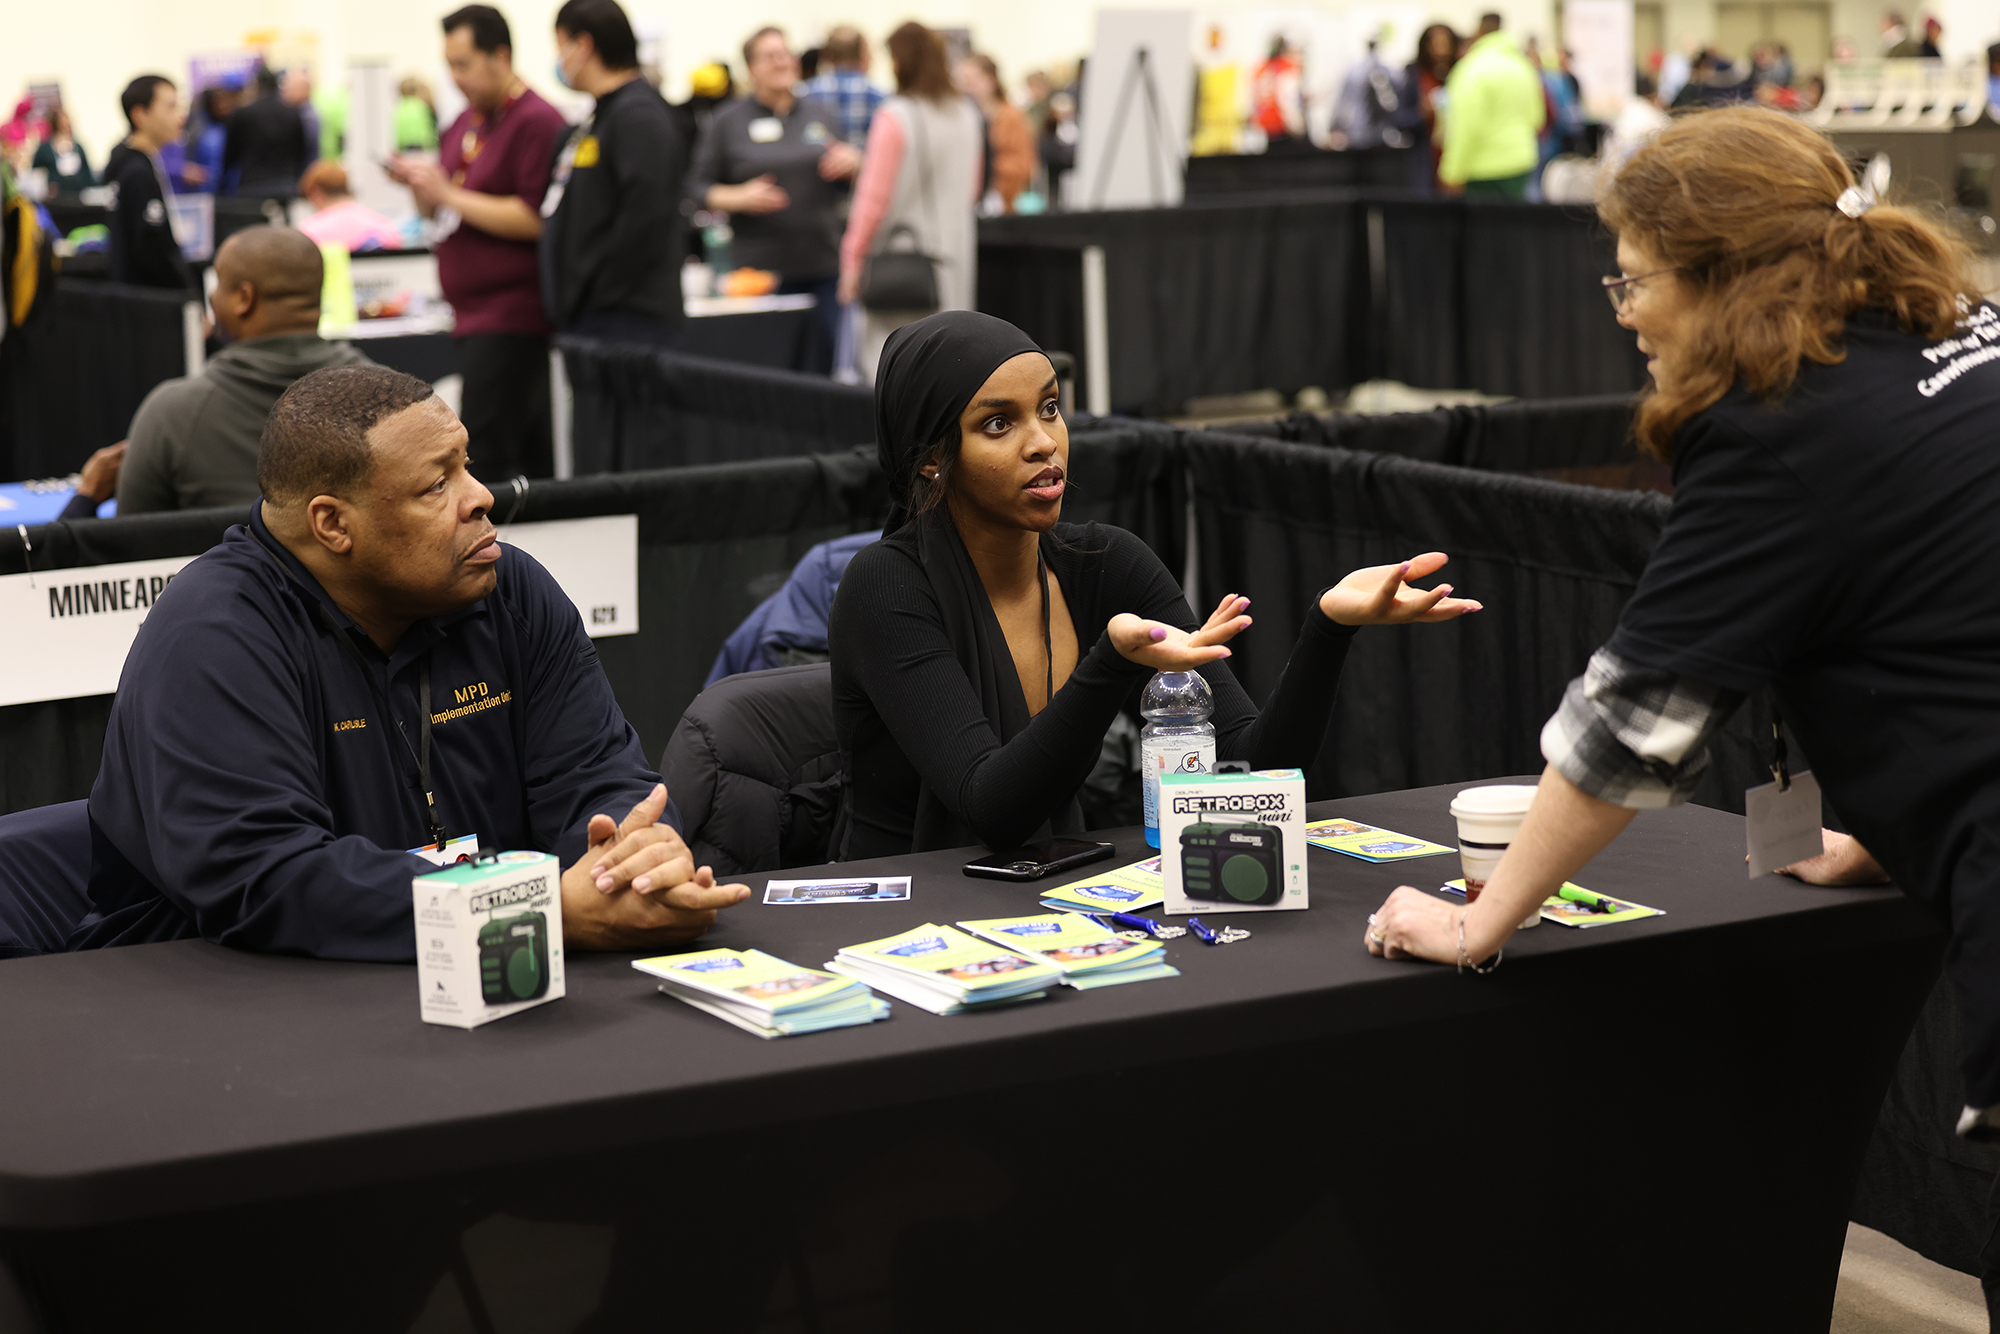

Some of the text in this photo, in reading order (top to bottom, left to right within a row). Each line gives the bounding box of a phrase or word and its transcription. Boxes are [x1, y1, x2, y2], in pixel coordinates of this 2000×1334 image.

[454, 682, 489, 704] MPD
[430, 695, 501, 724] Implementation
[1174, 793, 1285, 814] RETROBOX
[1257, 810, 1294, 822] mini
[470, 877, 547, 914] RETROBOX
